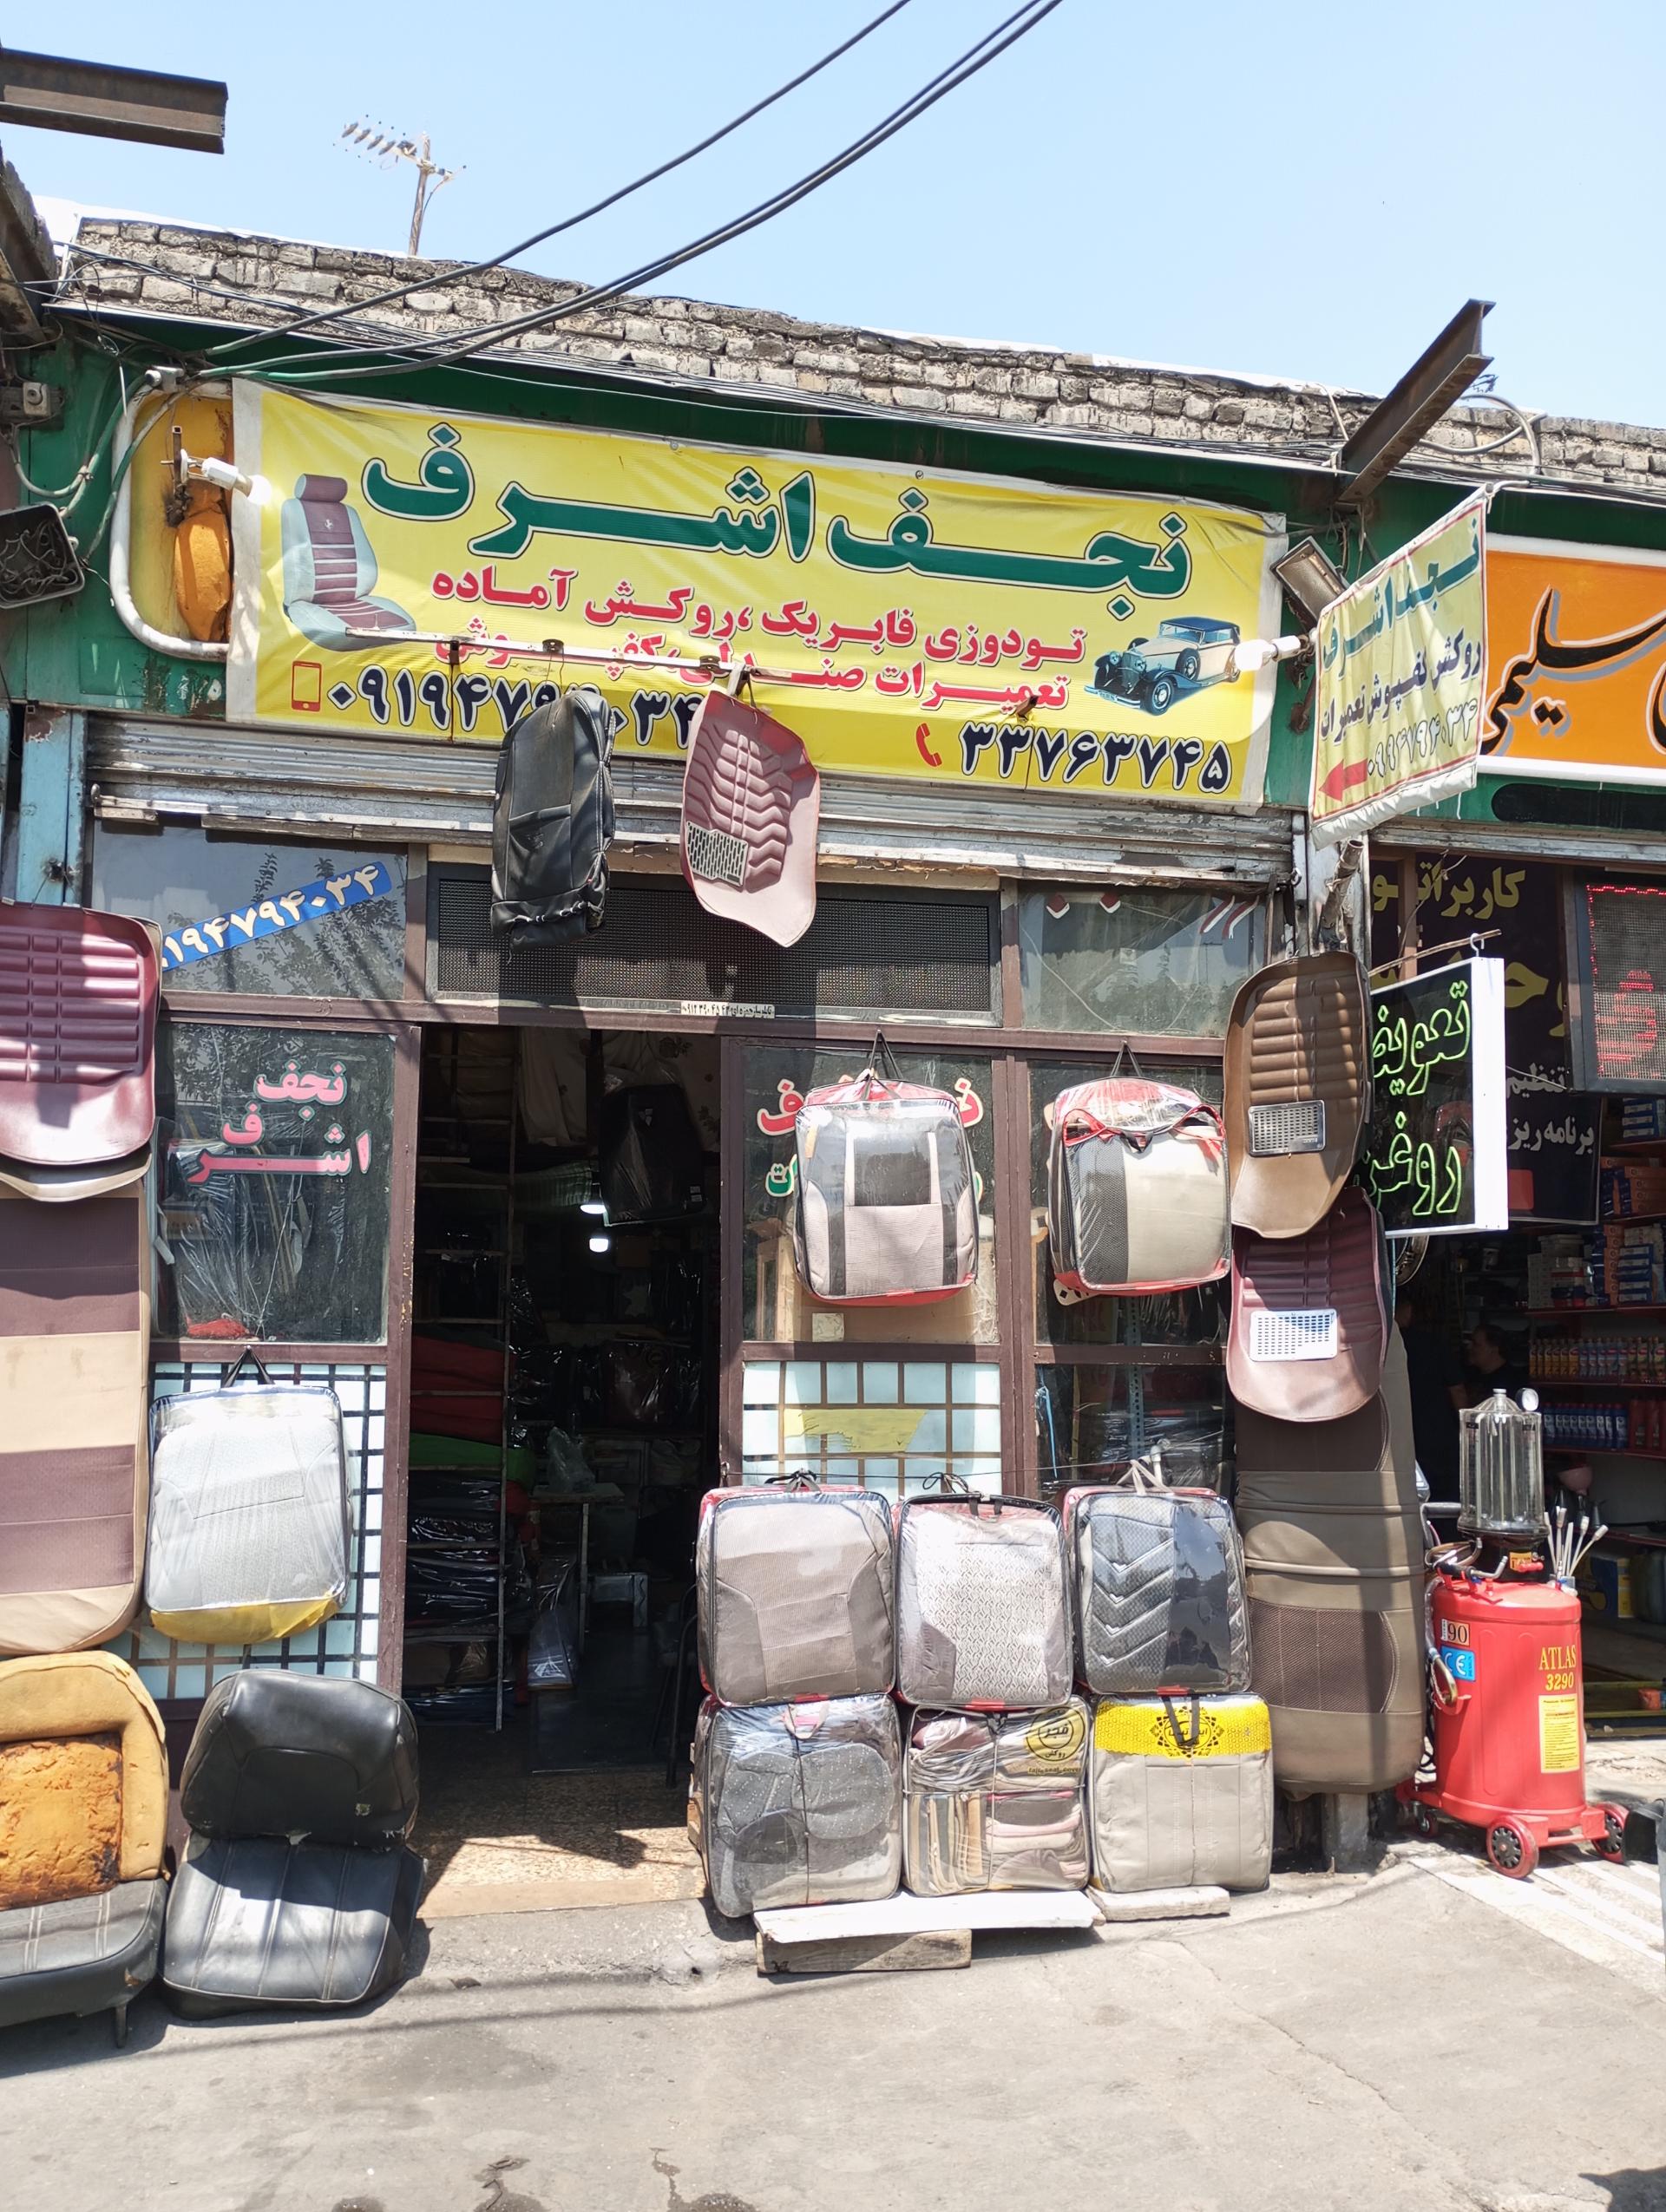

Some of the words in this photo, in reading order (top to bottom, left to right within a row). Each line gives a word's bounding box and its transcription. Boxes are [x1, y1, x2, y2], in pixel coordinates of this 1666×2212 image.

[362, 422, 814, 562] اشرف
[827, 487, 1191, 620] نجف
[430, 565, 579, 611] آماده
[762, 600, 917, 652] فابریک
[925, 625, 1086, 671] تودوزی
[1433, 627, 1482, 690] روکش
[874, 661, 1069, 713] تعمیرات
[959, 720, 1233, 794] ۳۳۷۶۳۷۴۵
[254, 1059, 346, 1121] نجف
[186, 1100, 373, 1186] اشرف
[1446, 1622, 1468, 1644] 90
[1538, 1645, 1577, 1670] ATLAS
[1545, 1672, 1575, 1691] 3290
